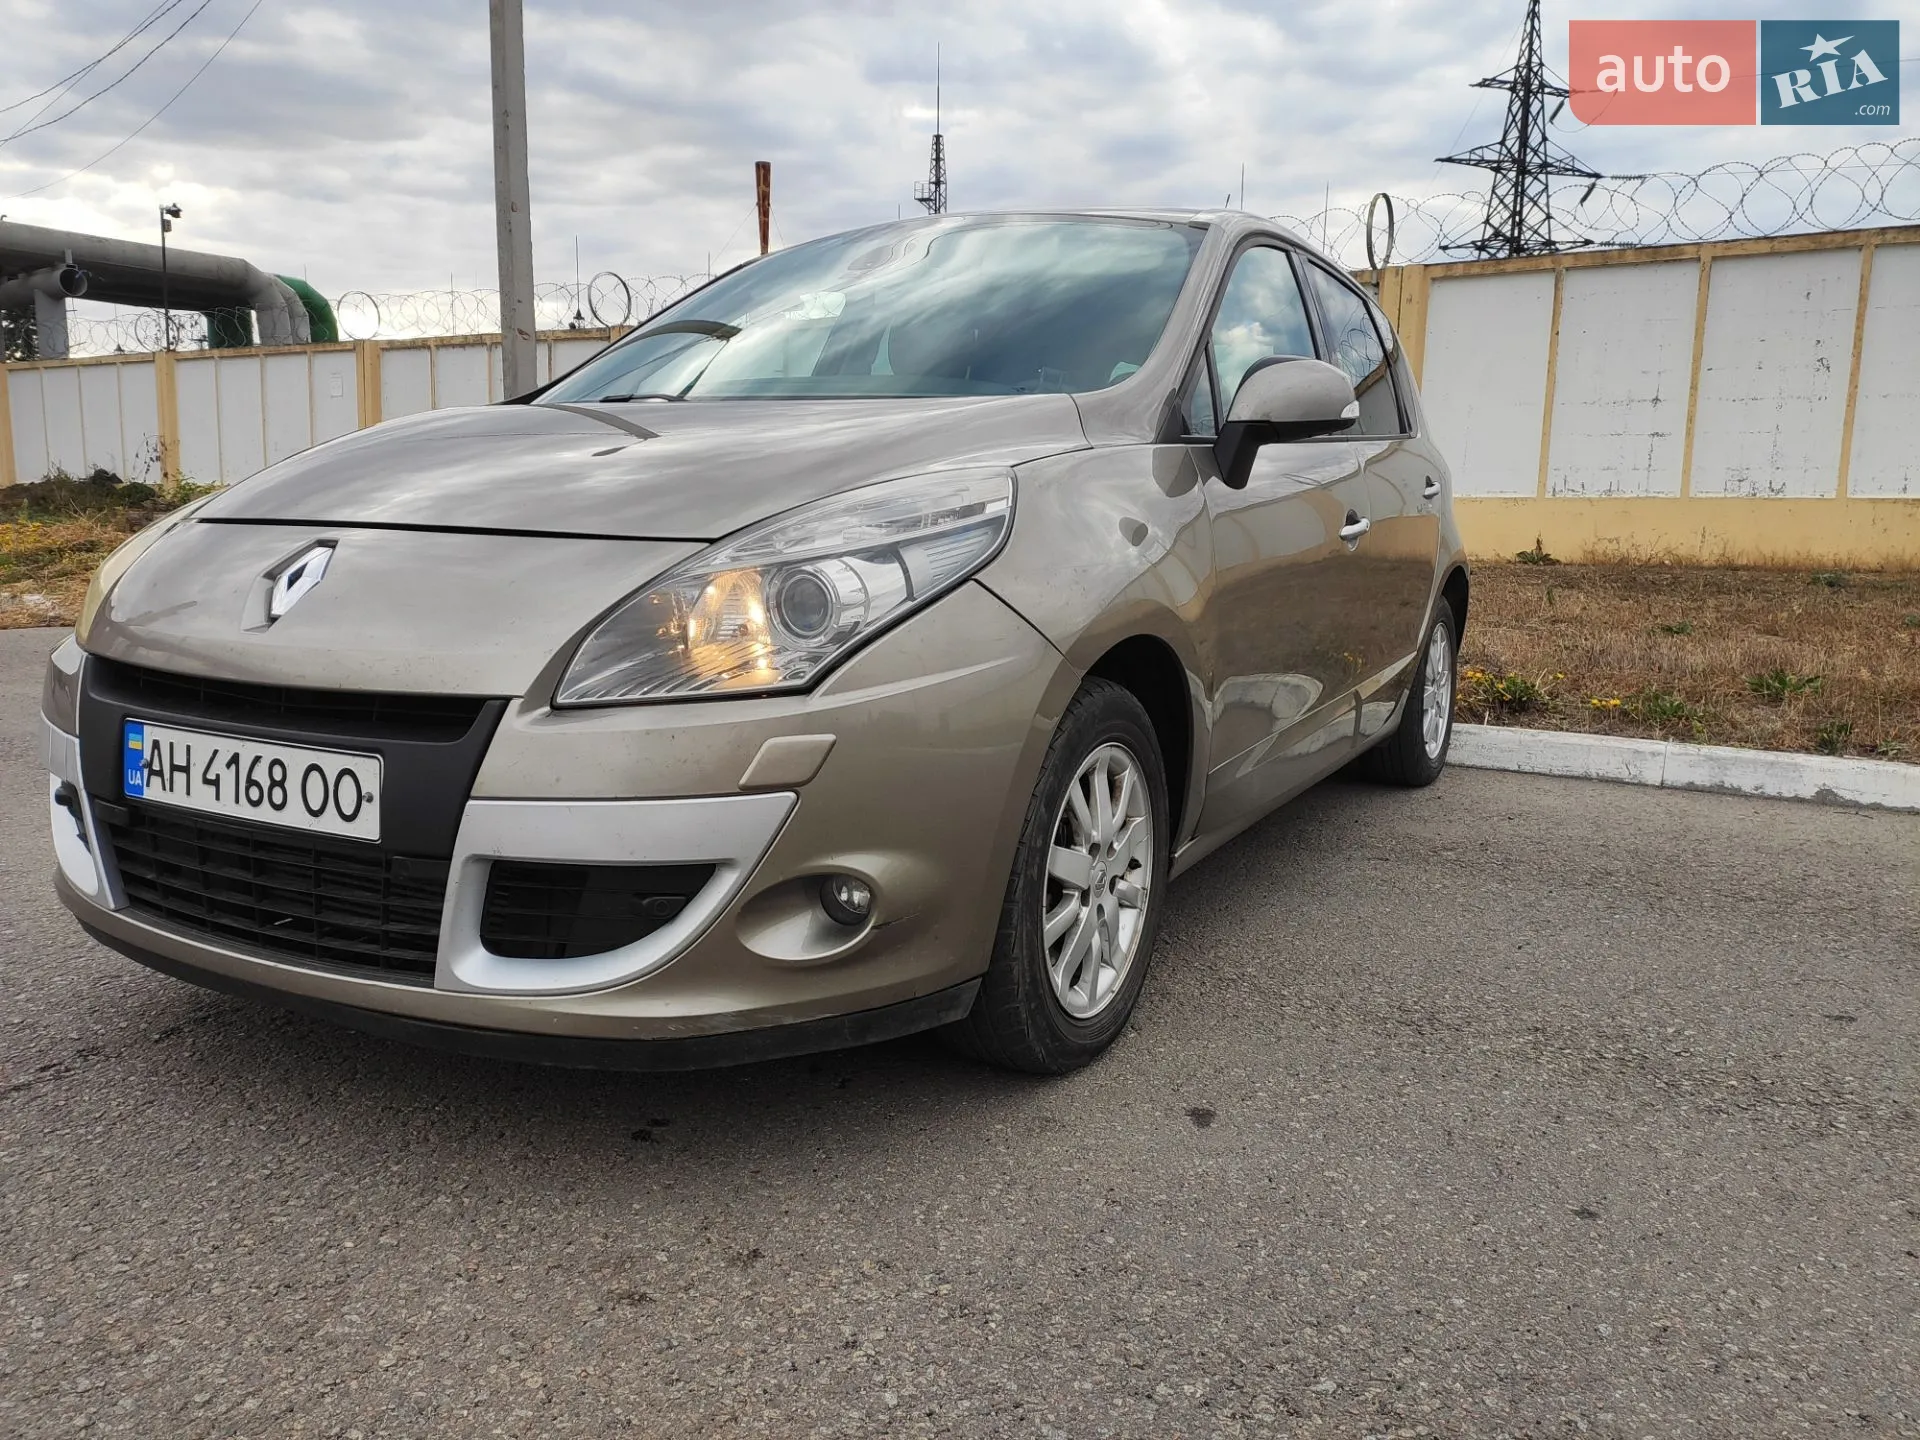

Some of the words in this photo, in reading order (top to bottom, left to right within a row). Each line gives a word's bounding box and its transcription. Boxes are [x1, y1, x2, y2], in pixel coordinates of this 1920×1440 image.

[128, 769, 142, 786] UA
[146, 739, 191, 796] AH
[202, 749, 287, 811] 4168
[301, 763, 362, 823] OO
